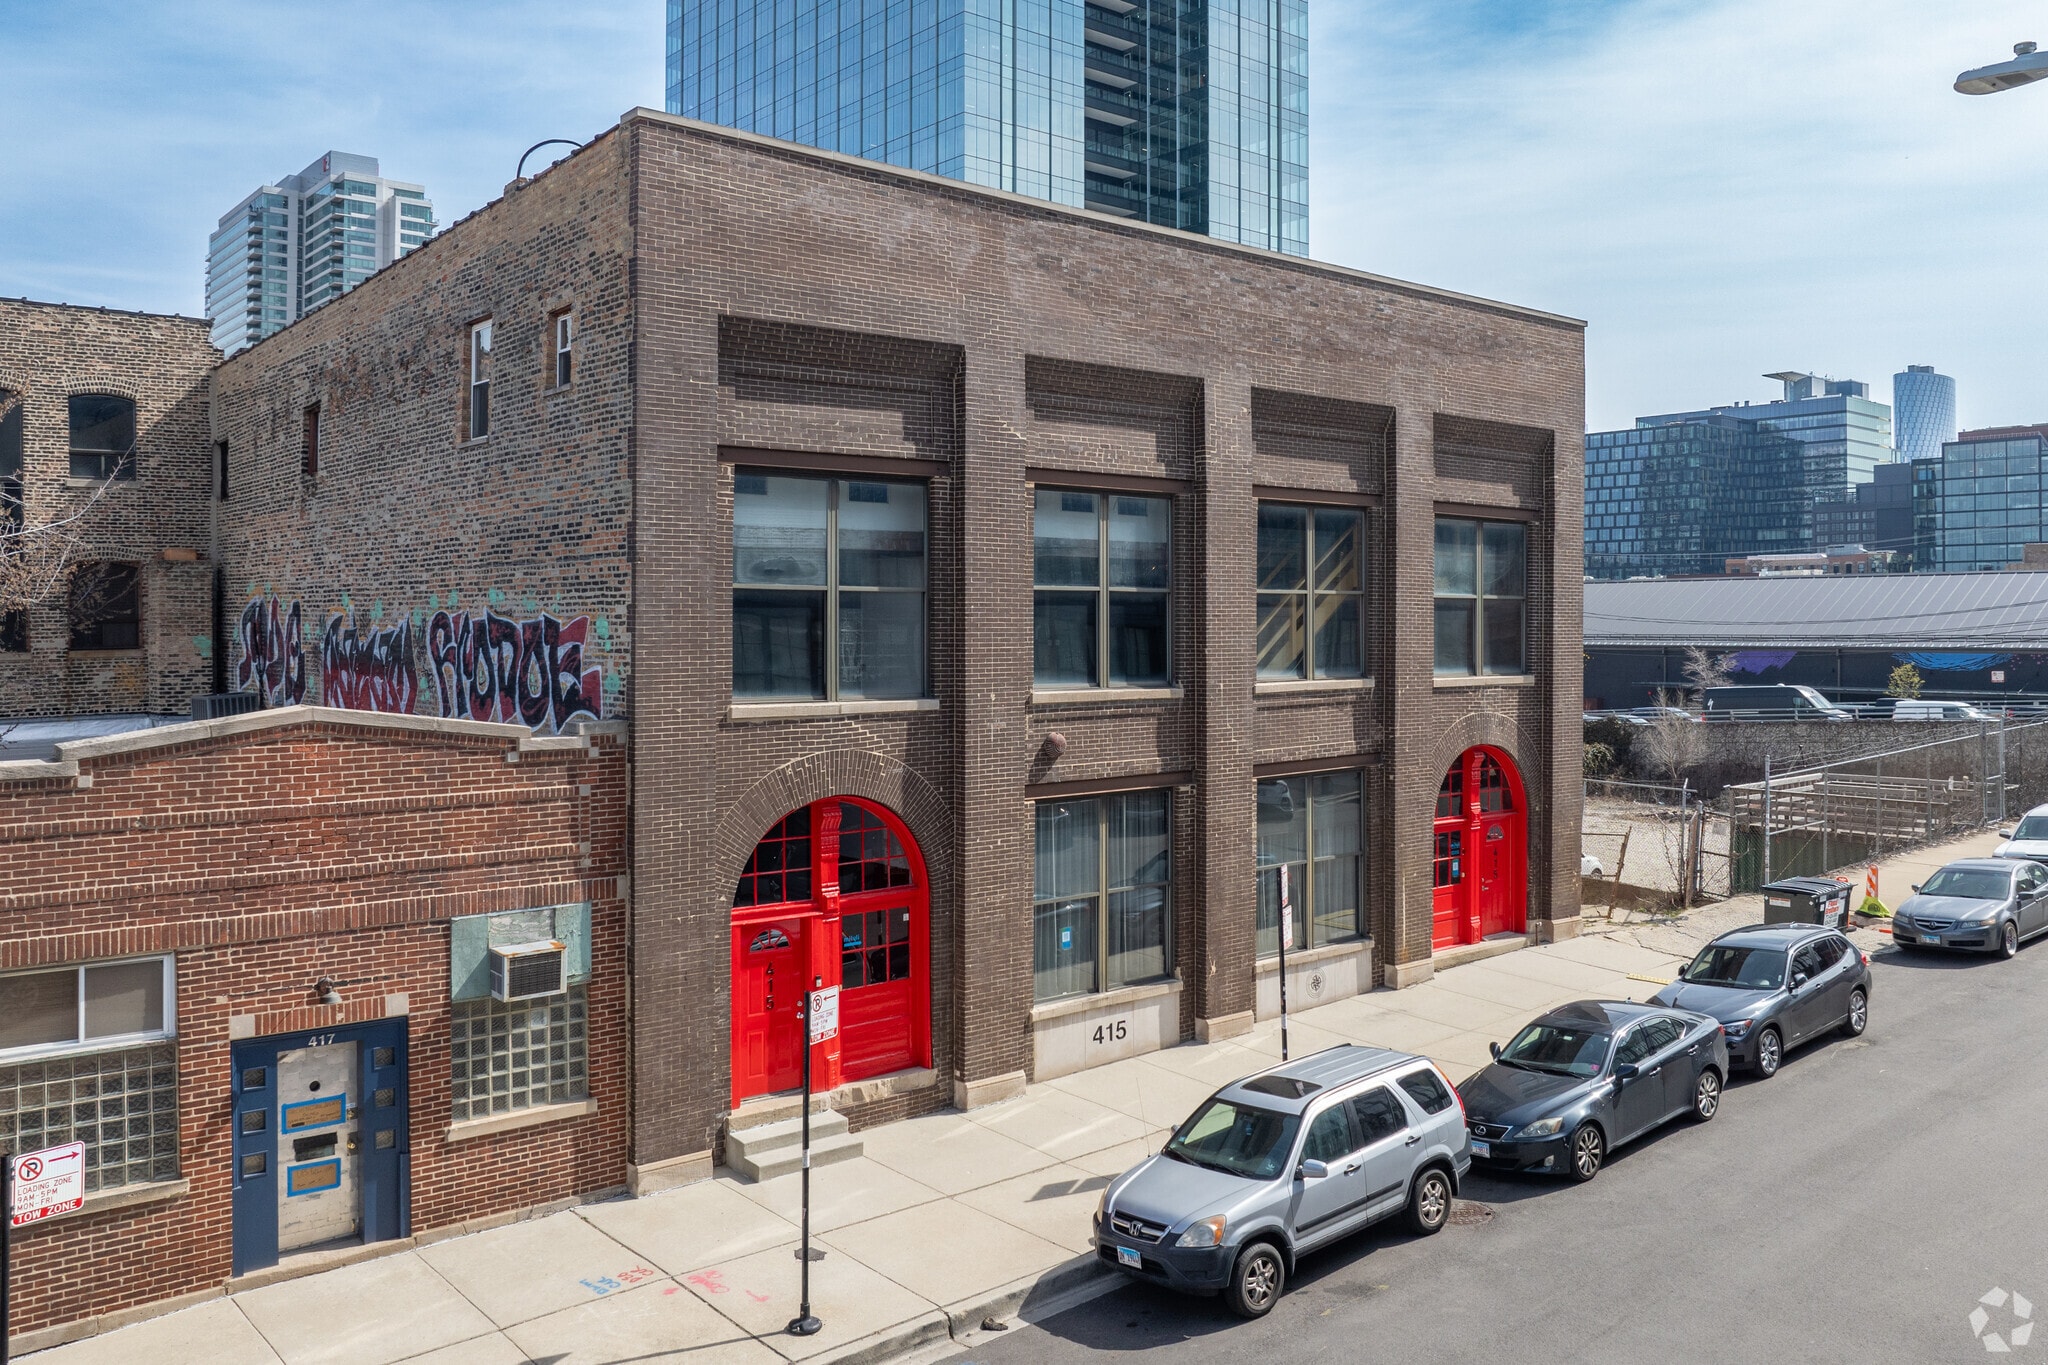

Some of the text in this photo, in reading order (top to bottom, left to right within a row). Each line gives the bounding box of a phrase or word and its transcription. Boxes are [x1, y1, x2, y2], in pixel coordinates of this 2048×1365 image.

[766, 961, 774, 1010] 415
[308, 1033, 335, 1047] 417
[1093, 1020, 1126, 1044] 415
[17, 1176, 72, 1196] LOADING ZONE
[17, 1200, 77, 1223] TOW ZONE
